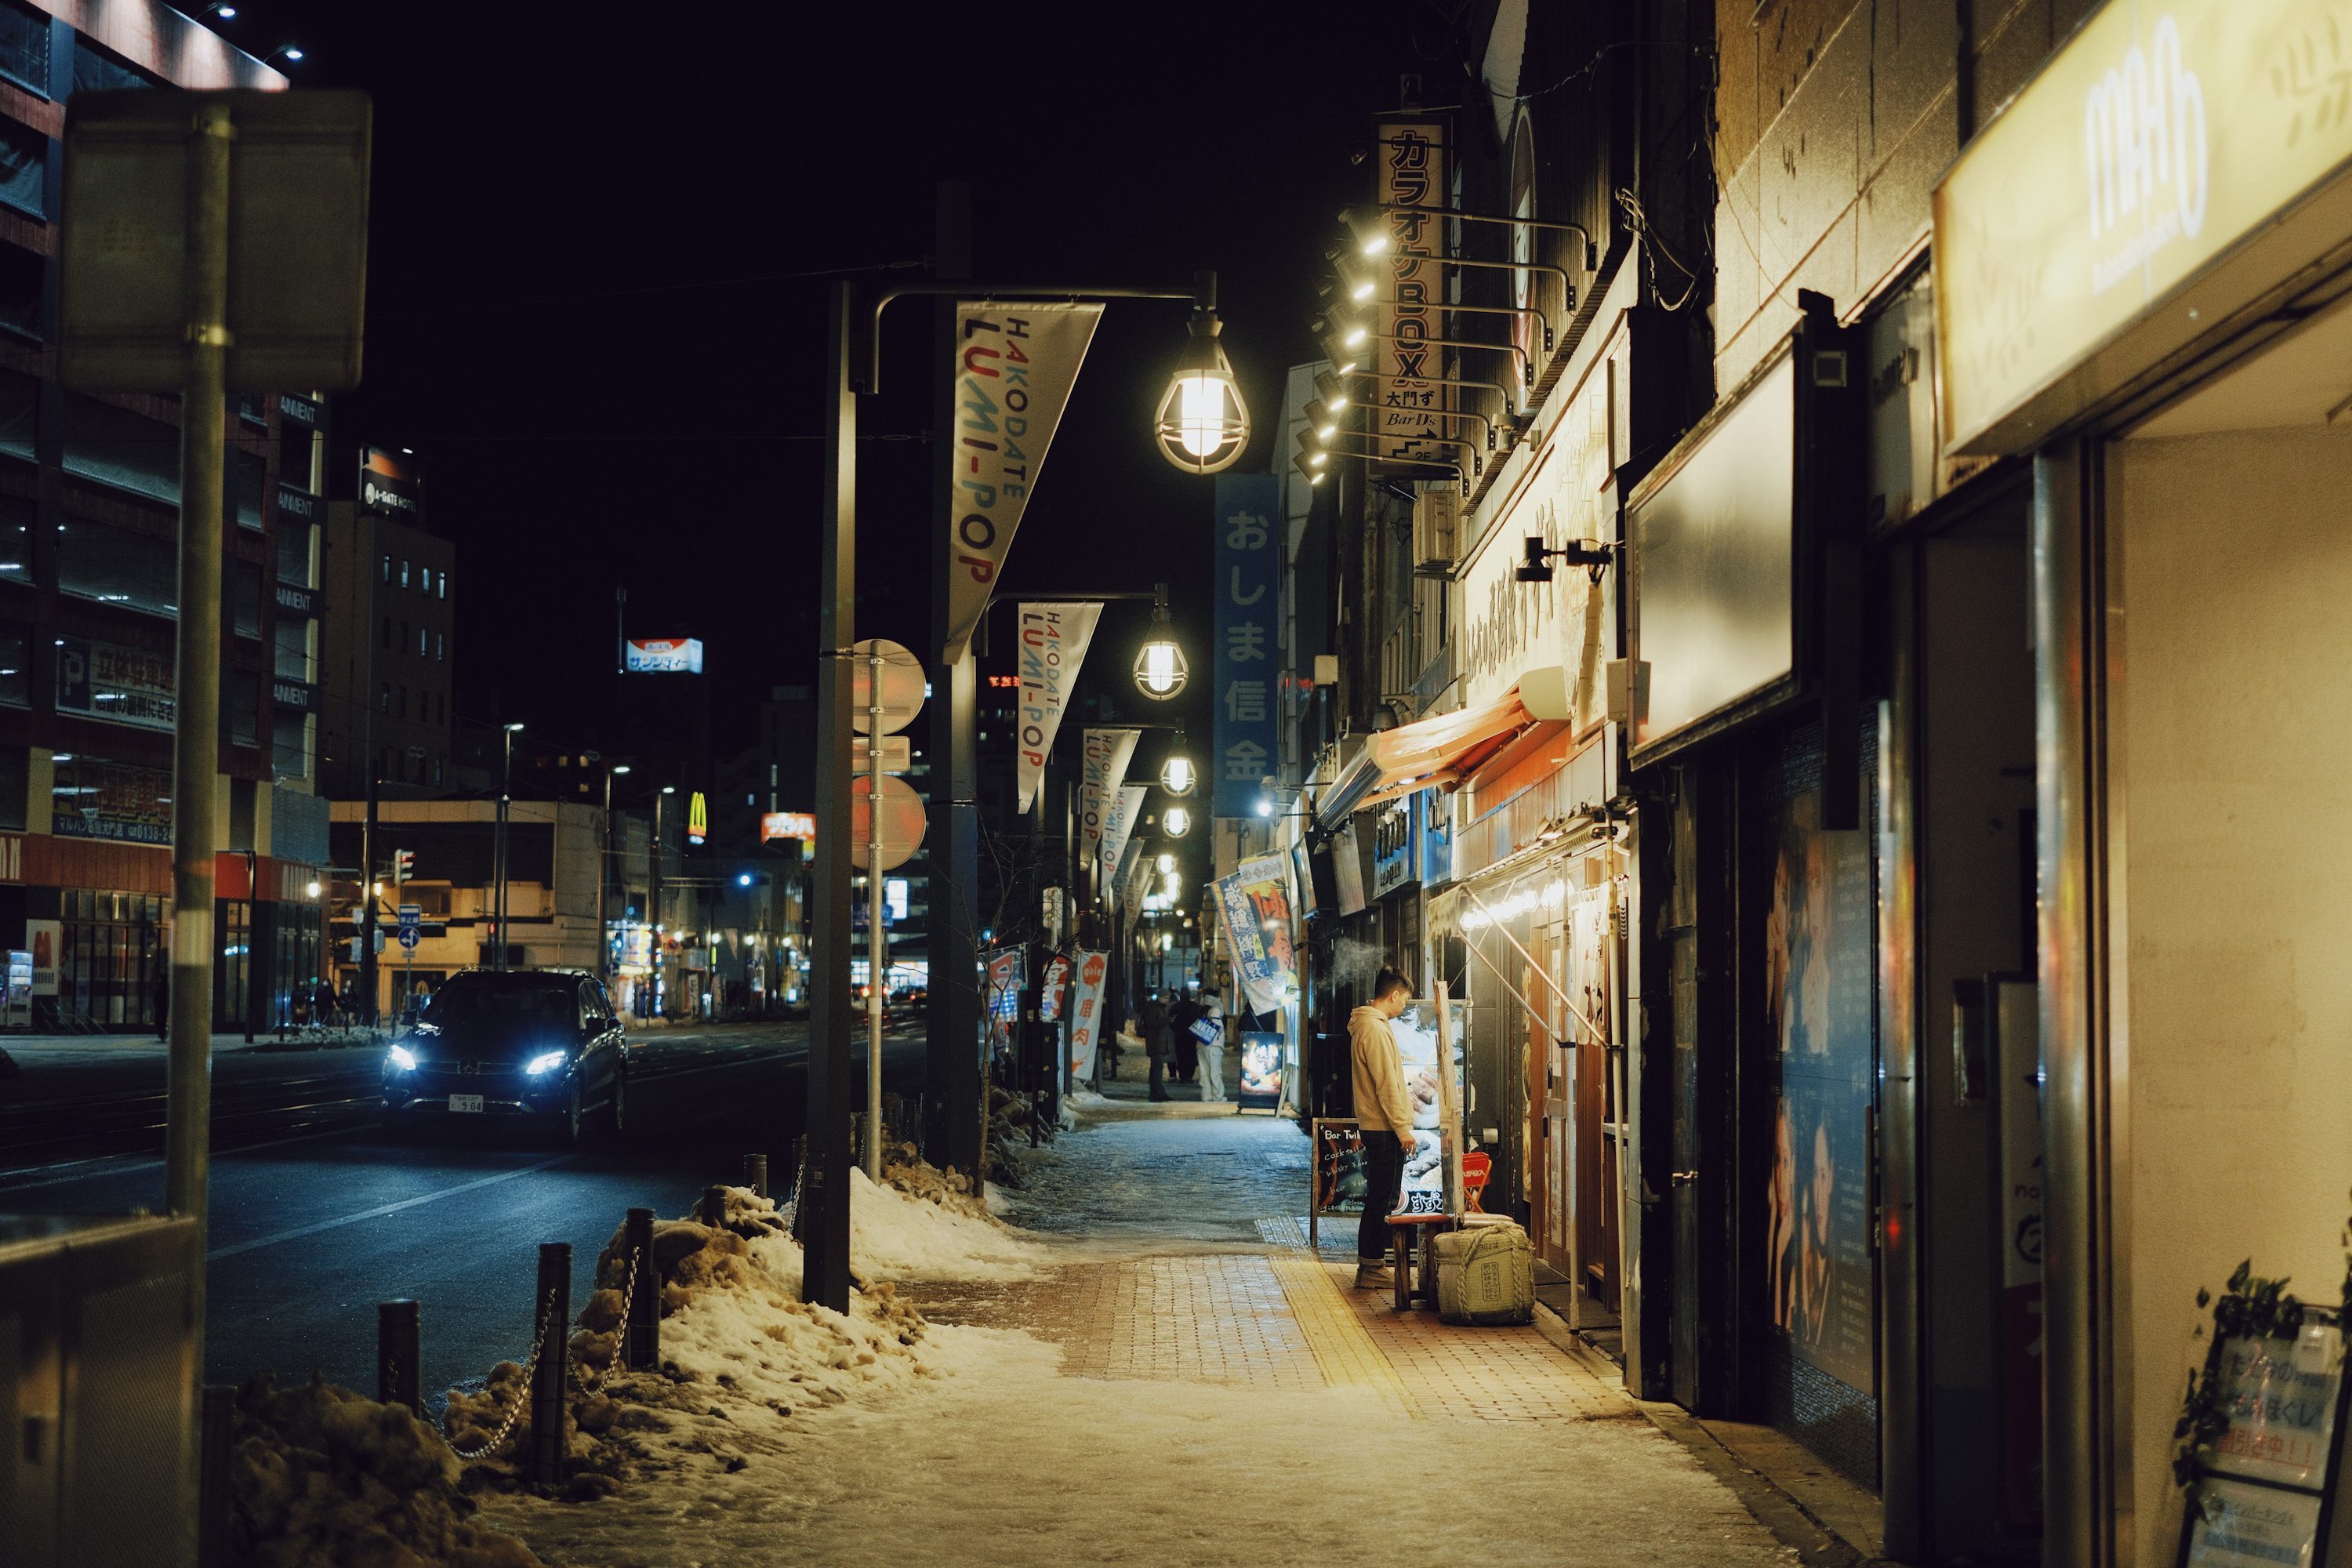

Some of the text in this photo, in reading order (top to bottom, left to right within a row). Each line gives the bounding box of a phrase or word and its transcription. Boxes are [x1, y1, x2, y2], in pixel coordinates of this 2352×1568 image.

[1391, 130, 1431, 387] カラオケBOX
[280, 396, 316, 423] AINMENT
[1003, 317, 1029, 498] HAKODATE
[1385, 390, 1436, 408] 大門ず
[1385, 412, 1415, 426] Bar
[957, 318, 1000, 584] LUMI-POP
[278, 491, 314, 517] AINMENT
[375, 490, 416, 513] A-GATE HOTEL
[276, 589, 312, 612] AINMENT
[1047, 612, 1061, 717] HAKODATE
[1225, 510, 1270, 782] おしま信金
[274, 685, 309, 708] AINMENT
[1022, 612, 1044, 768] LUMI-POP
[1083, 735, 1101, 840] LUMI-POP
[1100, 735, 1113, 807] HAKODATE
[1324, 1130, 1341, 1140] Bar
